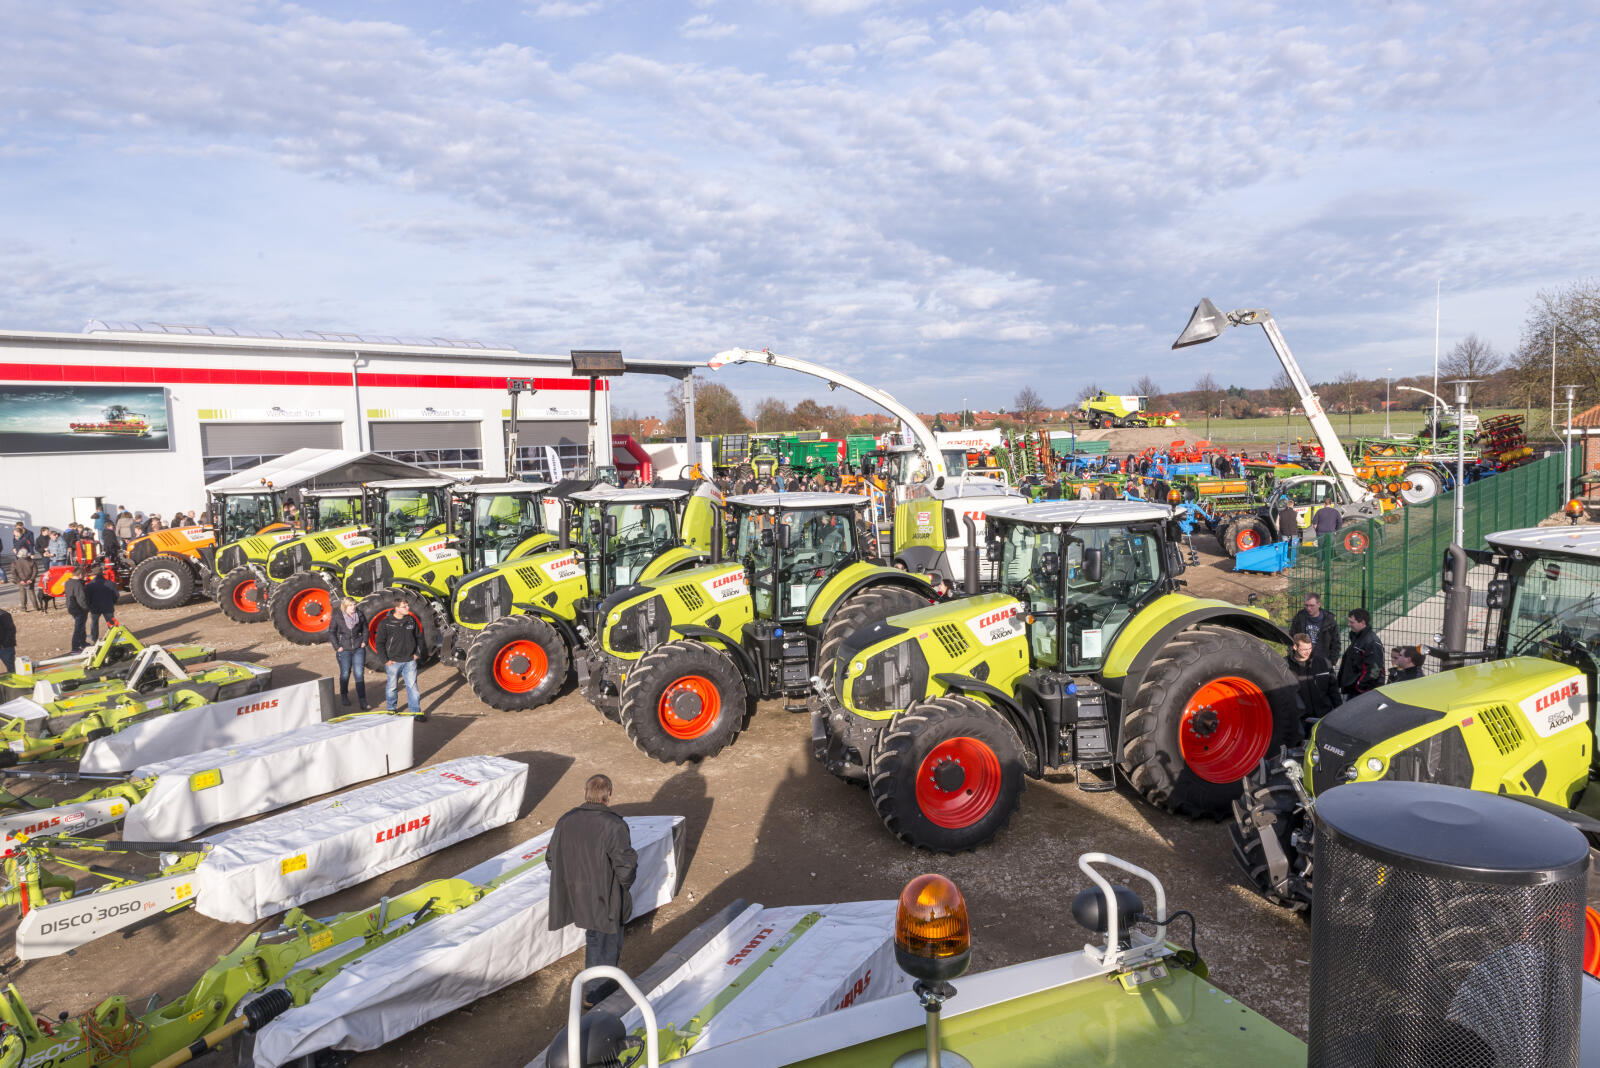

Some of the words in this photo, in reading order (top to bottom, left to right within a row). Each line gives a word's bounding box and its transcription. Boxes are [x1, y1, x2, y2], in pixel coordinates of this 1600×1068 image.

[712, 572, 744, 589] CLAAS
[722, 589, 740, 599] AXION
[979, 607, 1017, 629] CLAAS
[991, 629, 1013, 641] AXION
[1535, 681, 1579, 713] CLAAS
[236, 699, 279, 716] CLAAS
[1549, 713, 1574, 730] AXION
[1323, 743, 1345, 757] CLAAS
[440, 772, 481, 787] CLAAS
[375, 814, 432, 844] CLAAS
[40, 912, 93, 936] DISCO
[97, 900, 142, 921] 3050
[726, 928, 775, 967] CLAAS
